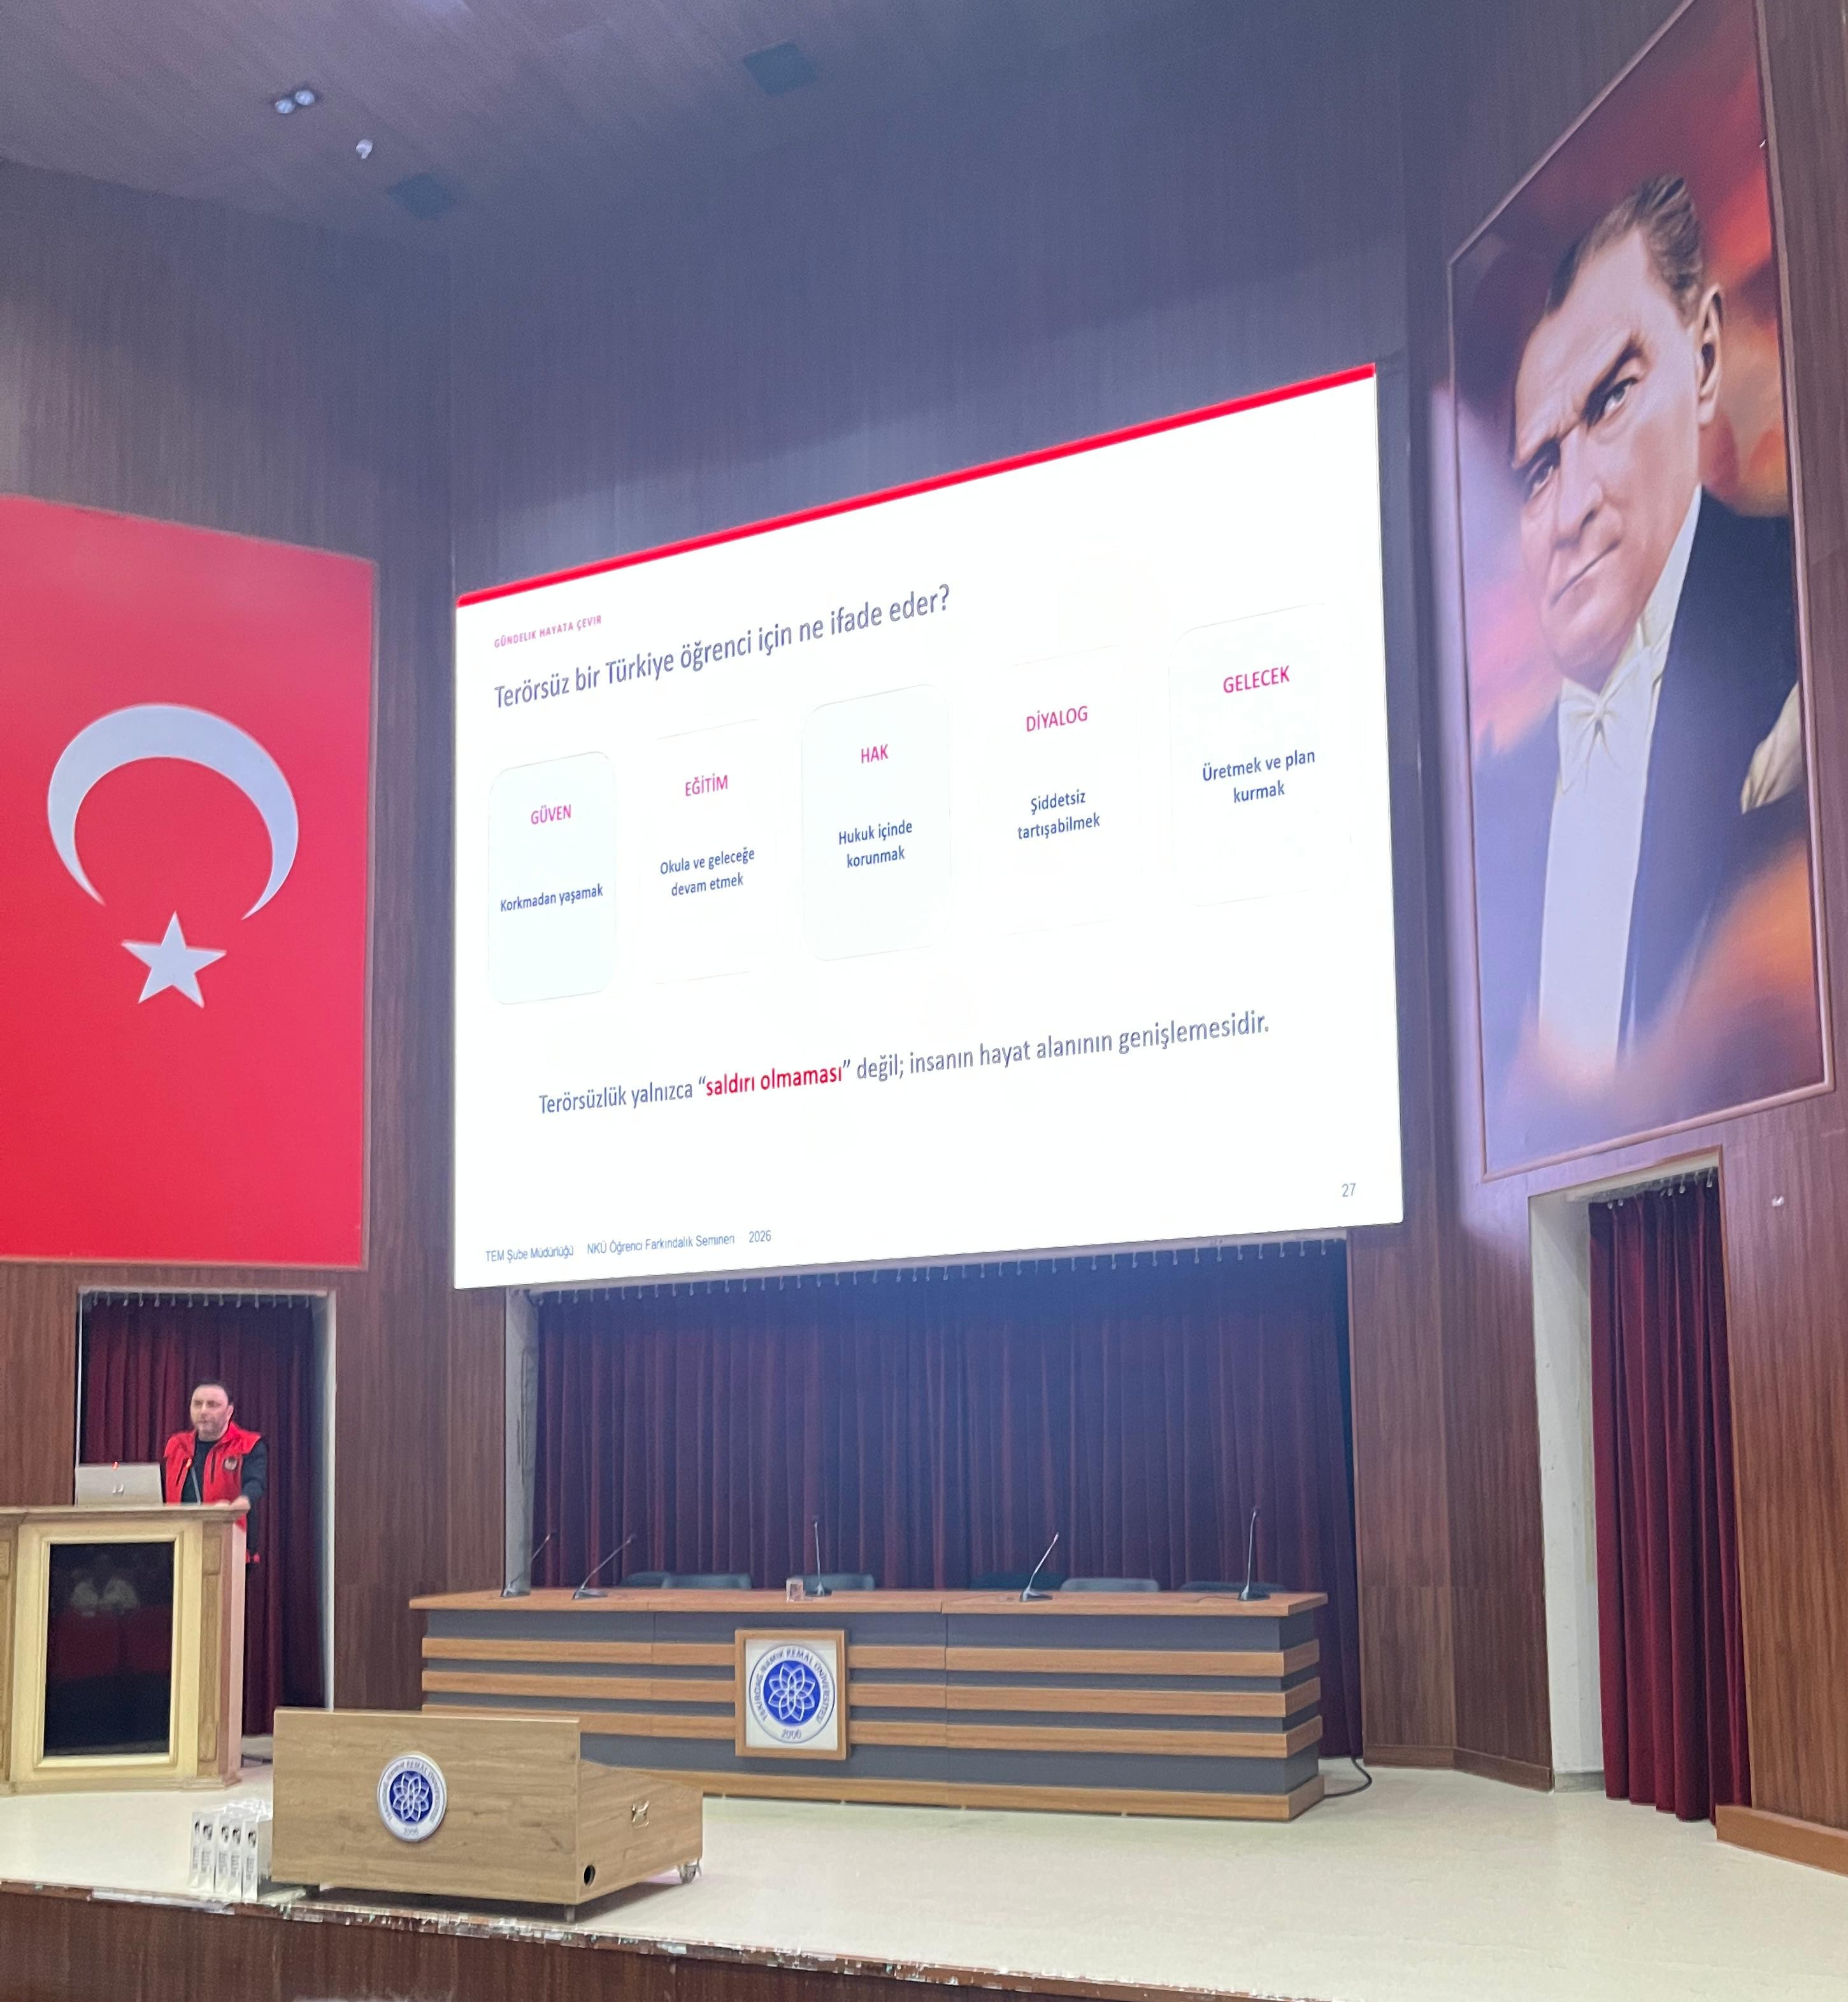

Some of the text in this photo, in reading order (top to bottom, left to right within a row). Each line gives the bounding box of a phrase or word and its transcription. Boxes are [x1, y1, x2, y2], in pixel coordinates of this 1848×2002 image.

[539, 622, 574, 638] HAYATA
[494, 583, 950, 708] Terörsüz bir Türkiye öğrenci için ne ifade eder?
[1222, 664, 1290, 694] GELECEK
[1026, 704, 1088, 733] DİYALOG
[861, 743, 889, 764] HAK
[1202, 749, 1315, 782] Üretmek ve plan
[685, 773, 728, 797] EĞİTİM
[1233, 779, 1286, 804] kurmak
[530, 804, 571, 826] GÜVEN
[1030, 789, 1085, 815] Şiddetsiz
[838, 819, 913, 846] Hukuk içinde
[1017, 812, 1101, 840] tartışabilmek
[660, 846, 755, 875] Okula ve geleceğe
[846, 845, 905, 869] korunmak
[499, 882, 604, 913] Korkmadan yaşamak
[671, 871, 744, 897] devam etmek
[538, 1085, 627, 1115] Terörsüzlük
[631, 1081, 693, 1110] yalnızca
[856, 1053, 904, 1083] değil;
[910, 1050, 973, 1074] insanın
[980, 1040, 1031, 1069] hayat
[1036, 1034, 1112, 1059] alanının
[1119, 1009, 1269, 1055] genişlemesidir.
[1342, 1182, 1356, 1198] 27
[485, 1249, 505, 1262] TEM
[587, 1240, 607, 1254] NKÜ
[749, 1229, 771, 1243] 2026
